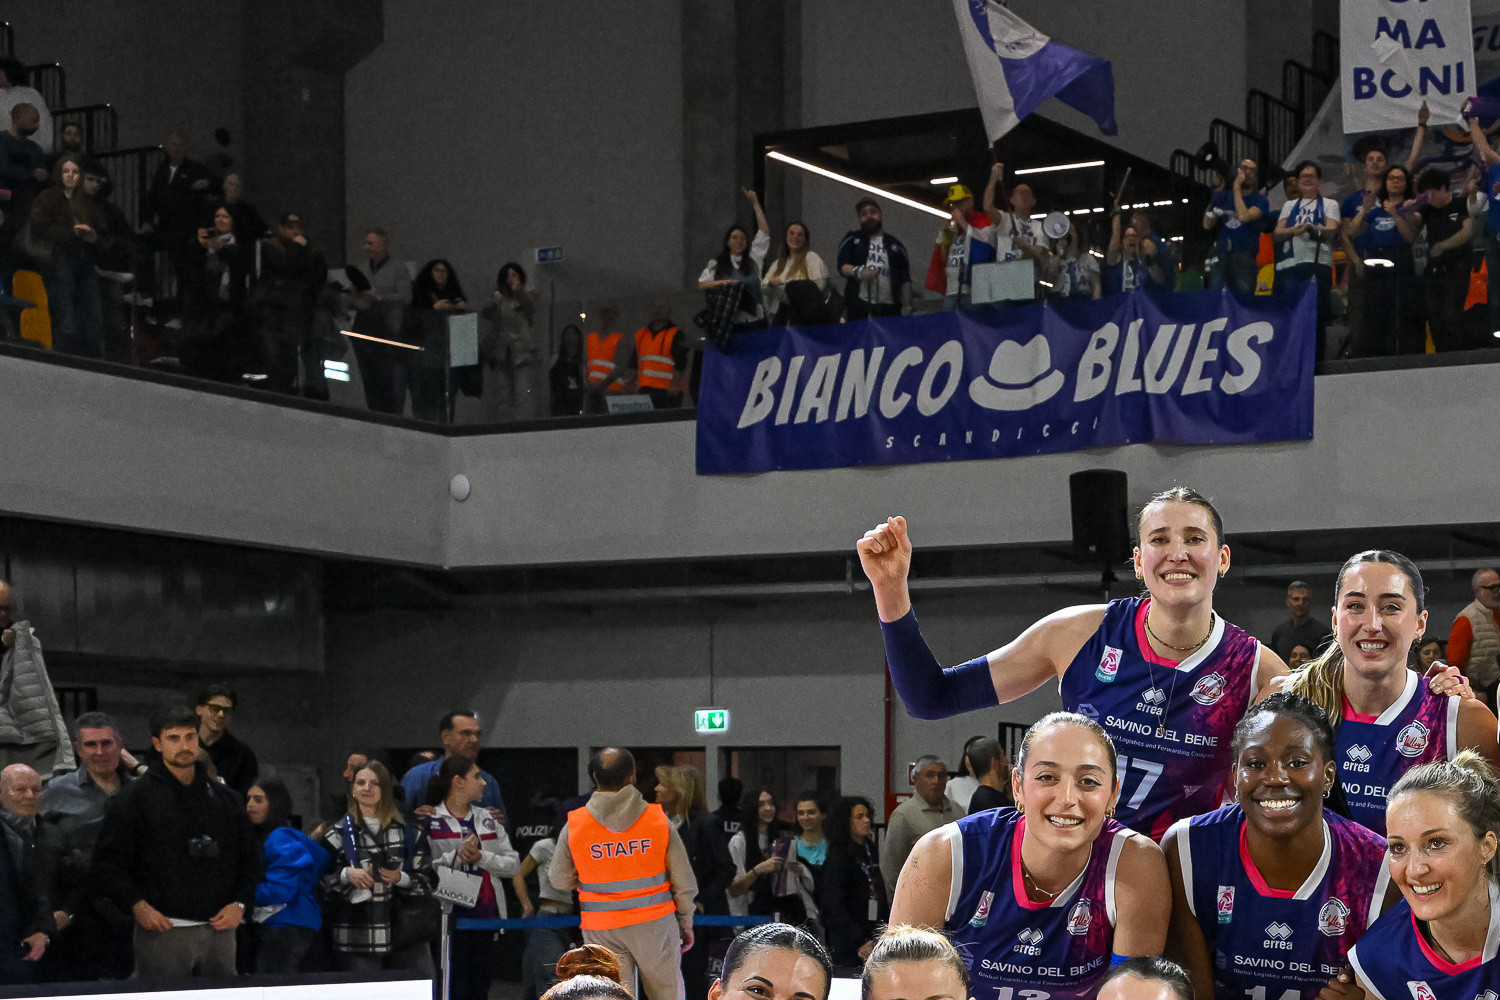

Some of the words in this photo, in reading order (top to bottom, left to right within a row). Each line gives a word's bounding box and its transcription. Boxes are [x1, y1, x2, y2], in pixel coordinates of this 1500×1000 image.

[1375, 16, 1446, 49] MA
[737, 339, 965, 430] BIANCO
[1073, 316, 1274, 403] BLUES
[884, 417, 1100, 450] SCANDICCI
[1136, 702, 1164, 717] errea
[1105, 715, 1152, 736] SAVINO
[1184, 733, 1219, 747] BENE
[1343, 761, 1370, 773] errea
[1364, 785, 1388, 798] DEL
[590, 838, 652, 860] STAFF
[1013, 944, 1042, 956] errea
[1263, 939, 1293, 950] errea
[980, 959, 1033, 975] SAVINO
[1037, 966, 1065, 977] DEL
[1070, 955, 1104, 977] BENE
[1234, 955, 1285, 970] SAVINO
[1289, 962, 1316, 973] DEL
